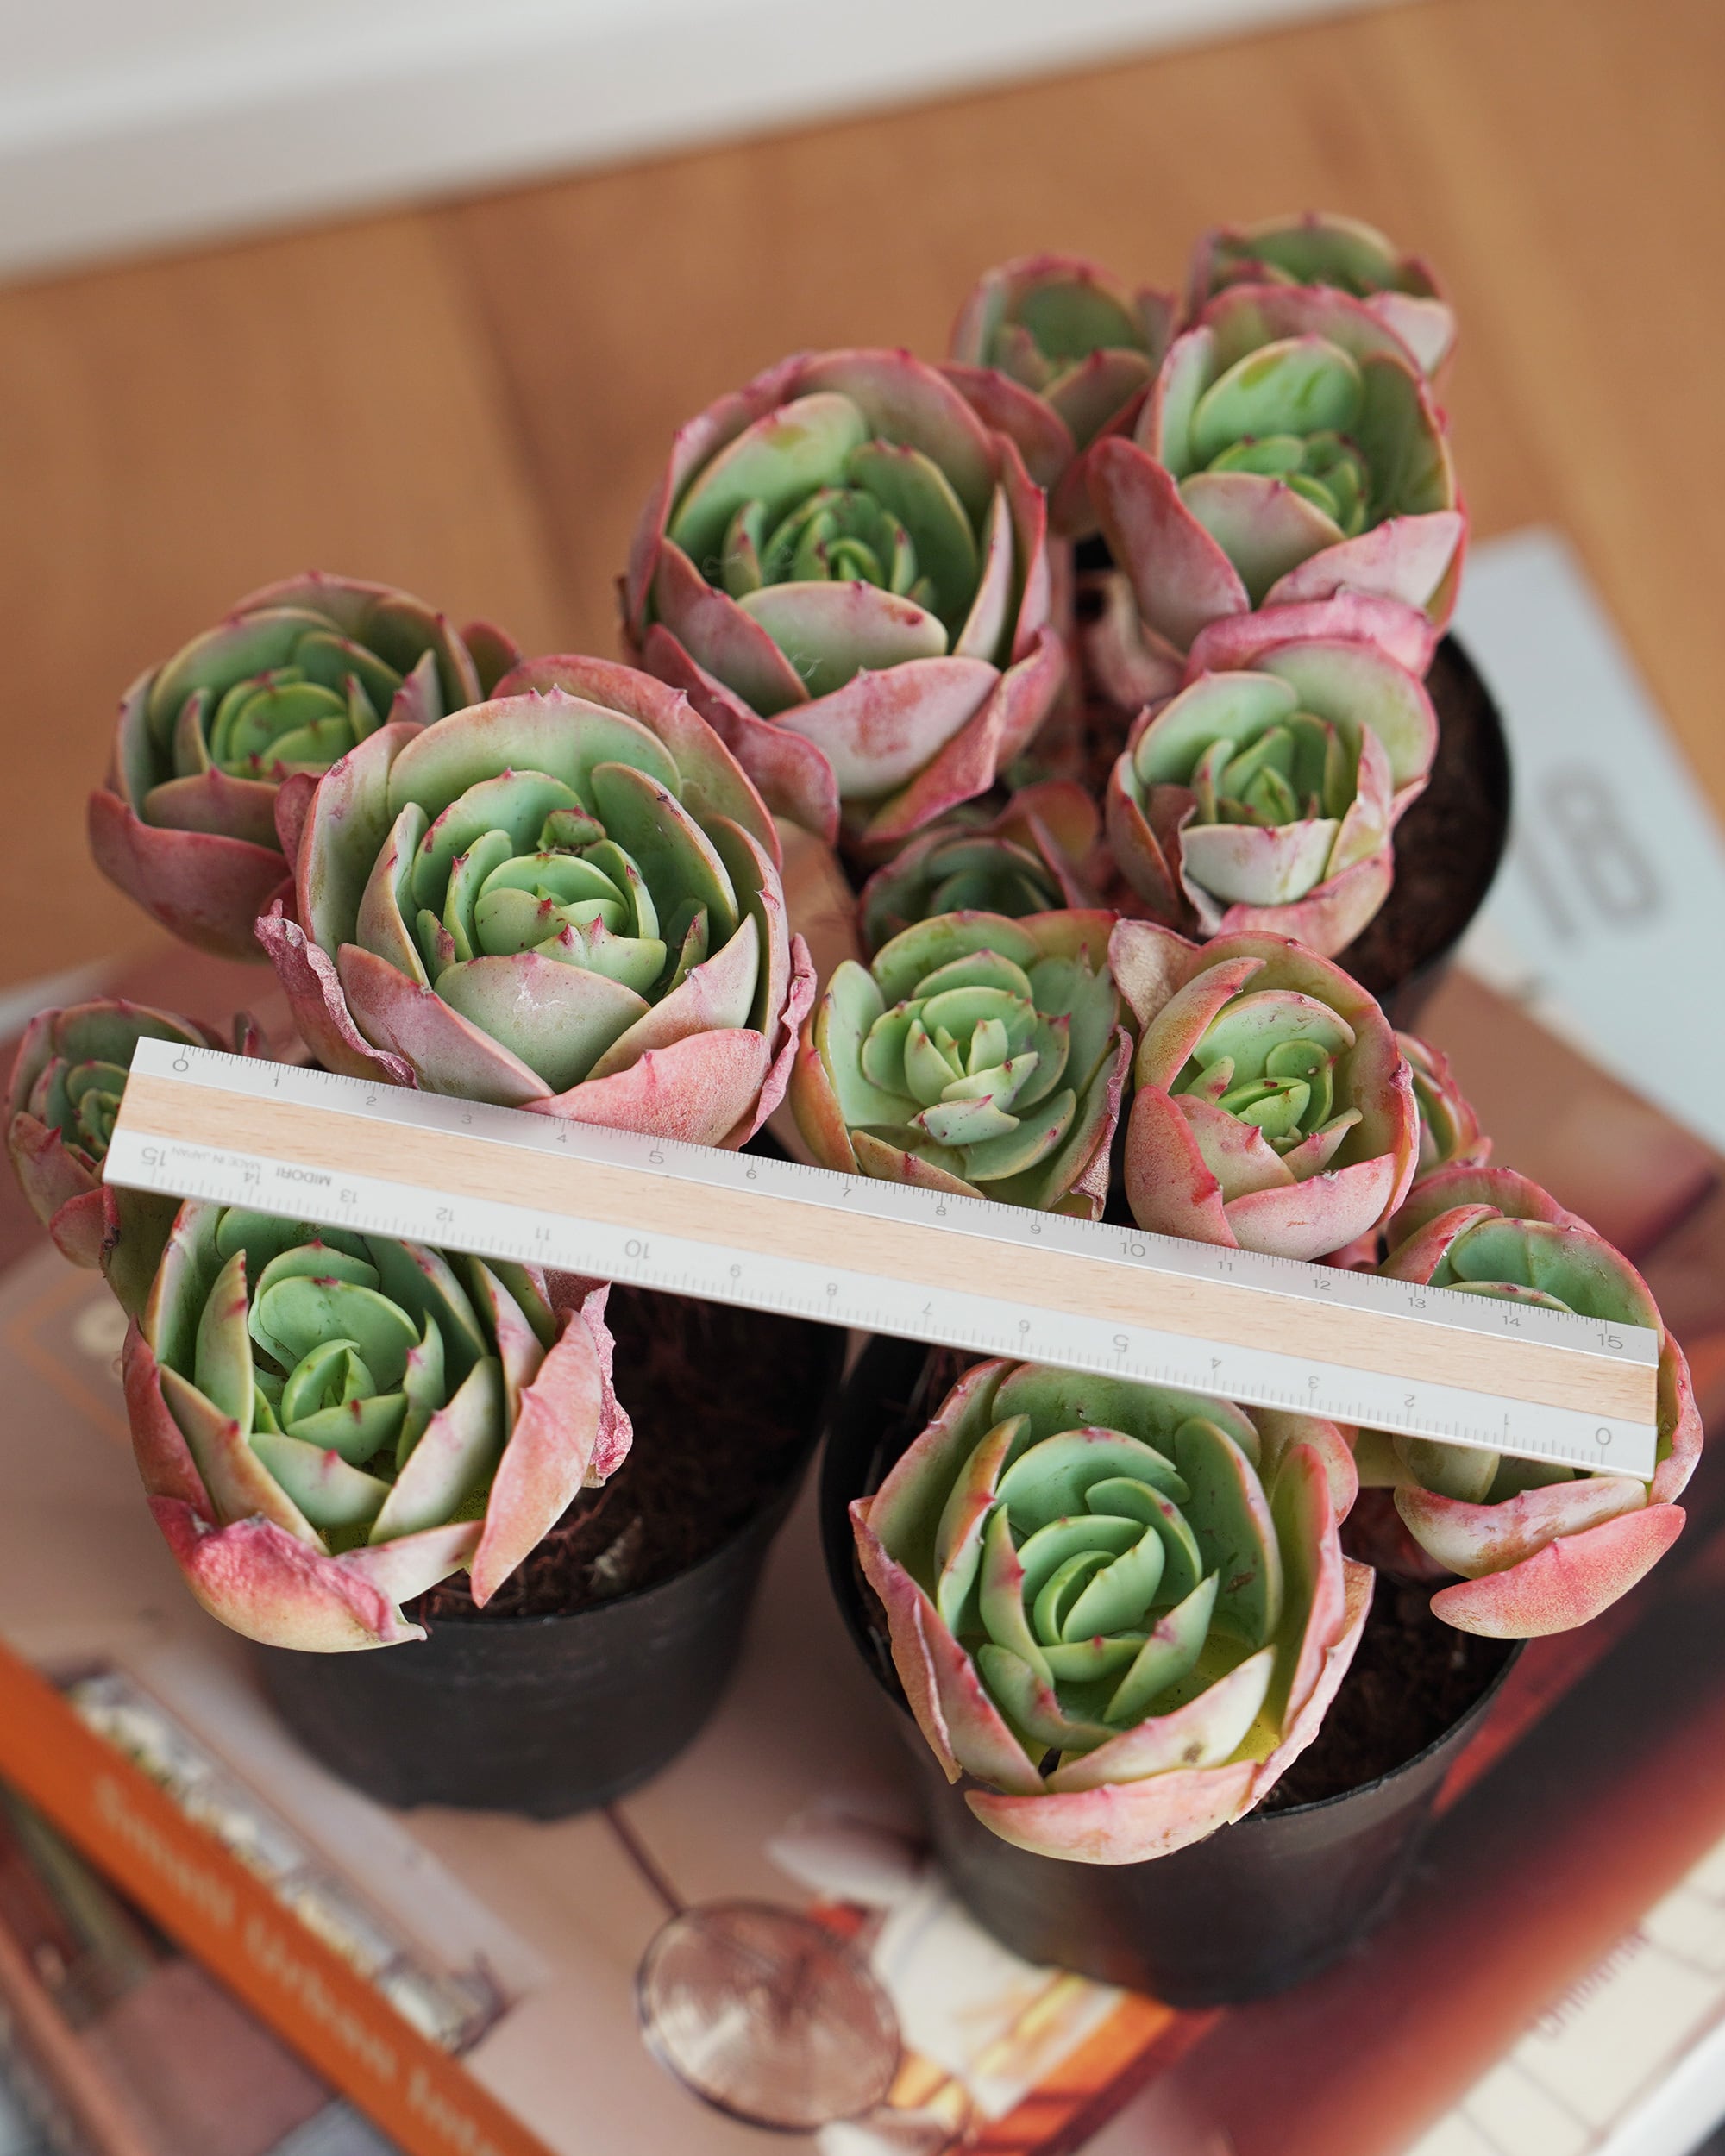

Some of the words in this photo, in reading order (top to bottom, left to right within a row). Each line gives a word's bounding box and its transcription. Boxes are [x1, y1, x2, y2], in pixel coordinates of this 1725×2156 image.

[141, 1146, 166, 1166] 15
[172, 1146, 210, 1160] JAPAN
[213, 1155, 223, 1163] IN
[228, 1156, 261, 1171] MADE
[244, 1172, 260, 1185] 14
[276, 1167, 331, 1187] MIDORI
[340, 1189, 357, 1204] 13
[172, 1059, 189, 1072] 0
[273, 1078, 279, 1087] 1
[366, 1096, 378, 1106] 2
[461, 1114, 472, 1124] 3
[556, 1134, 568, 1144] 4
[649, 1150, 664, 1164] 5
[745, 1169, 757, 1180] 6
[841, 1187, 852, 1197] 7
[936, 1206, 947, 1216] 8
[1030, 1224, 1041, 1234] 9
[1120, 1242, 1145, 1257] 10
[1218, 1261, 1233, 1271] 11
[1313, 1279, 1331, 1290] 12
[1408, 1297, 1427, 1308] 13
[1502, 1315, 1521, 1327] 14
[1596, 1333, 1623, 1350] 15
[436, 1207, 454, 1221] 12
[535, 1226, 550, 1241] 11
[624, 1239, 651, 1259] 10
[730, 1264, 741, 1278] 9
[826, 1283, 838, 1296] 8
[922, 1301, 932, 1315] 7
[1019, 1319, 1031, 1333] 6
[1113, 1334, 1129, 1353] 5
[1209, 1357, 1221, 1369] 4
[1308, 1376, 1320, 1389] 3
[1404, 1394, 1415, 1407] 2
[1503, 1413, 1509, 1426] 1
[1596, 1427, 1612, 1445] 0
